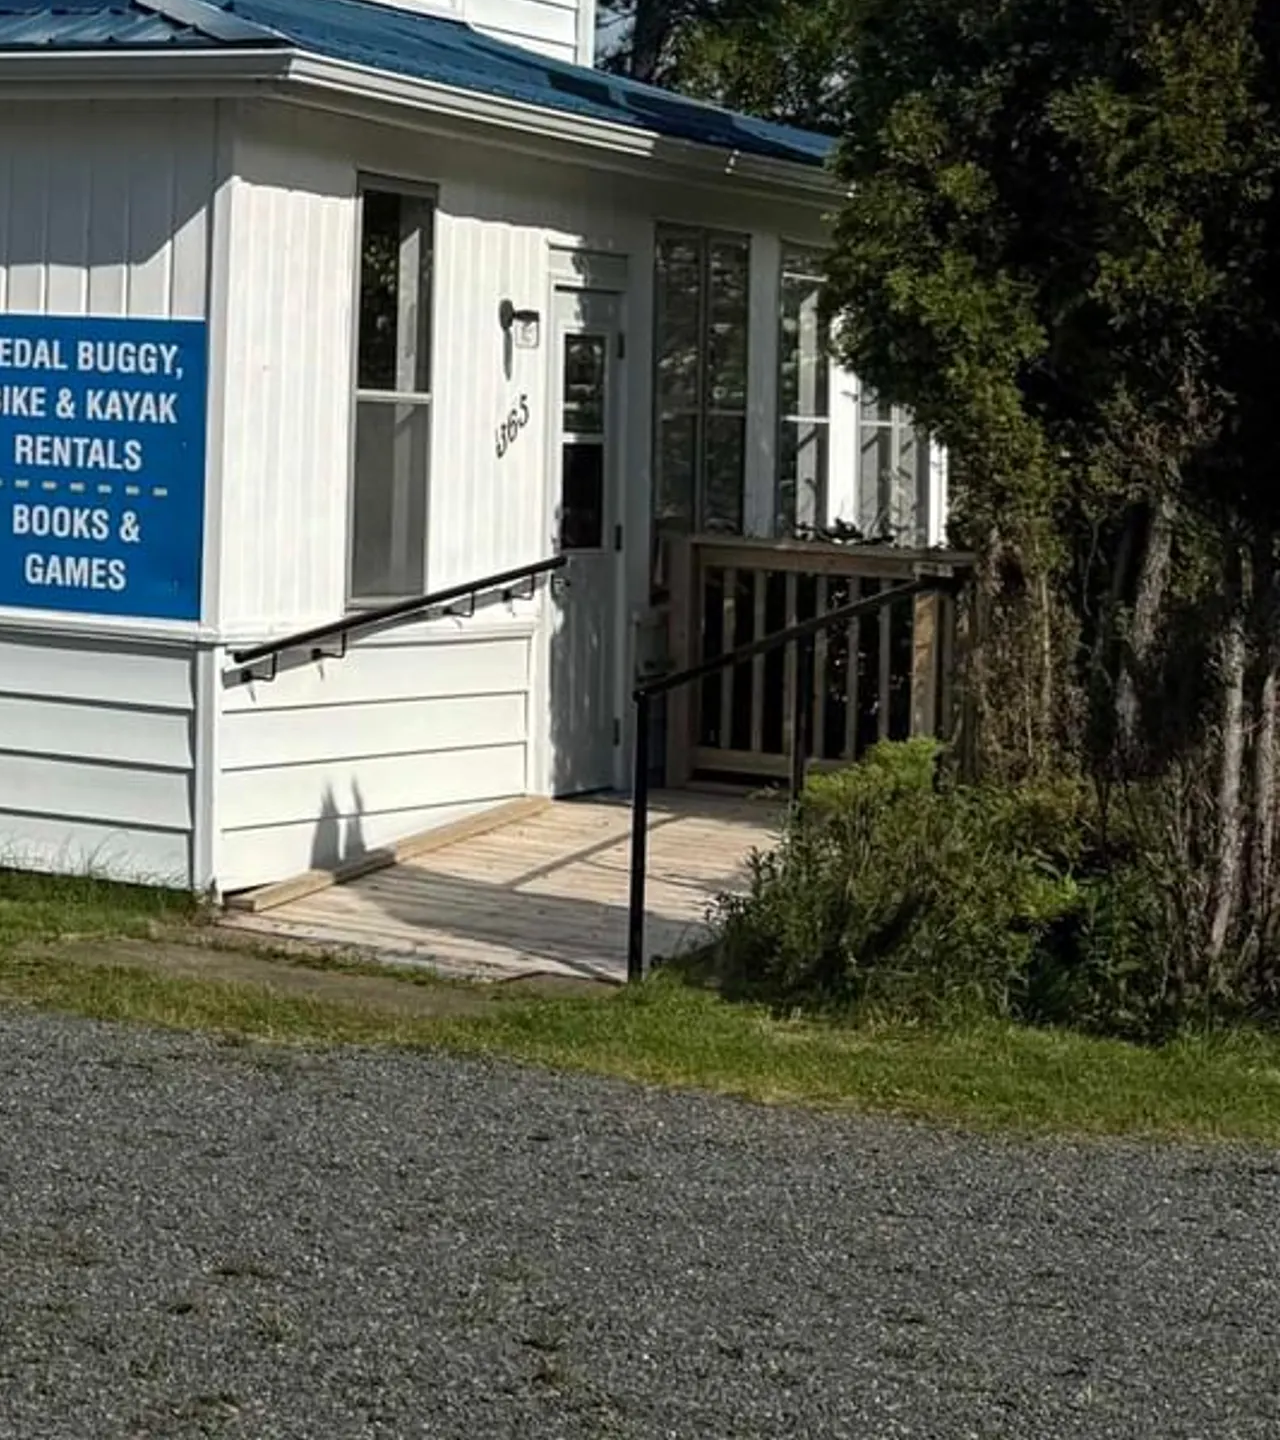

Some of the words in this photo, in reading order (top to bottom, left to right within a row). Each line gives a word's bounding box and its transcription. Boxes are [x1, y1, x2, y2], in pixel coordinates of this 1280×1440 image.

[77, 340, 184, 380] BUGGY,
[55, 389, 76, 419] &
[86, 389, 178, 424] KAYAK
[14, 434, 142, 472] RENTALS
[12, 503, 109, 542] BOOKS
[119, 510, 141, 543] &
[24, 552, 127, 591] GAMES
